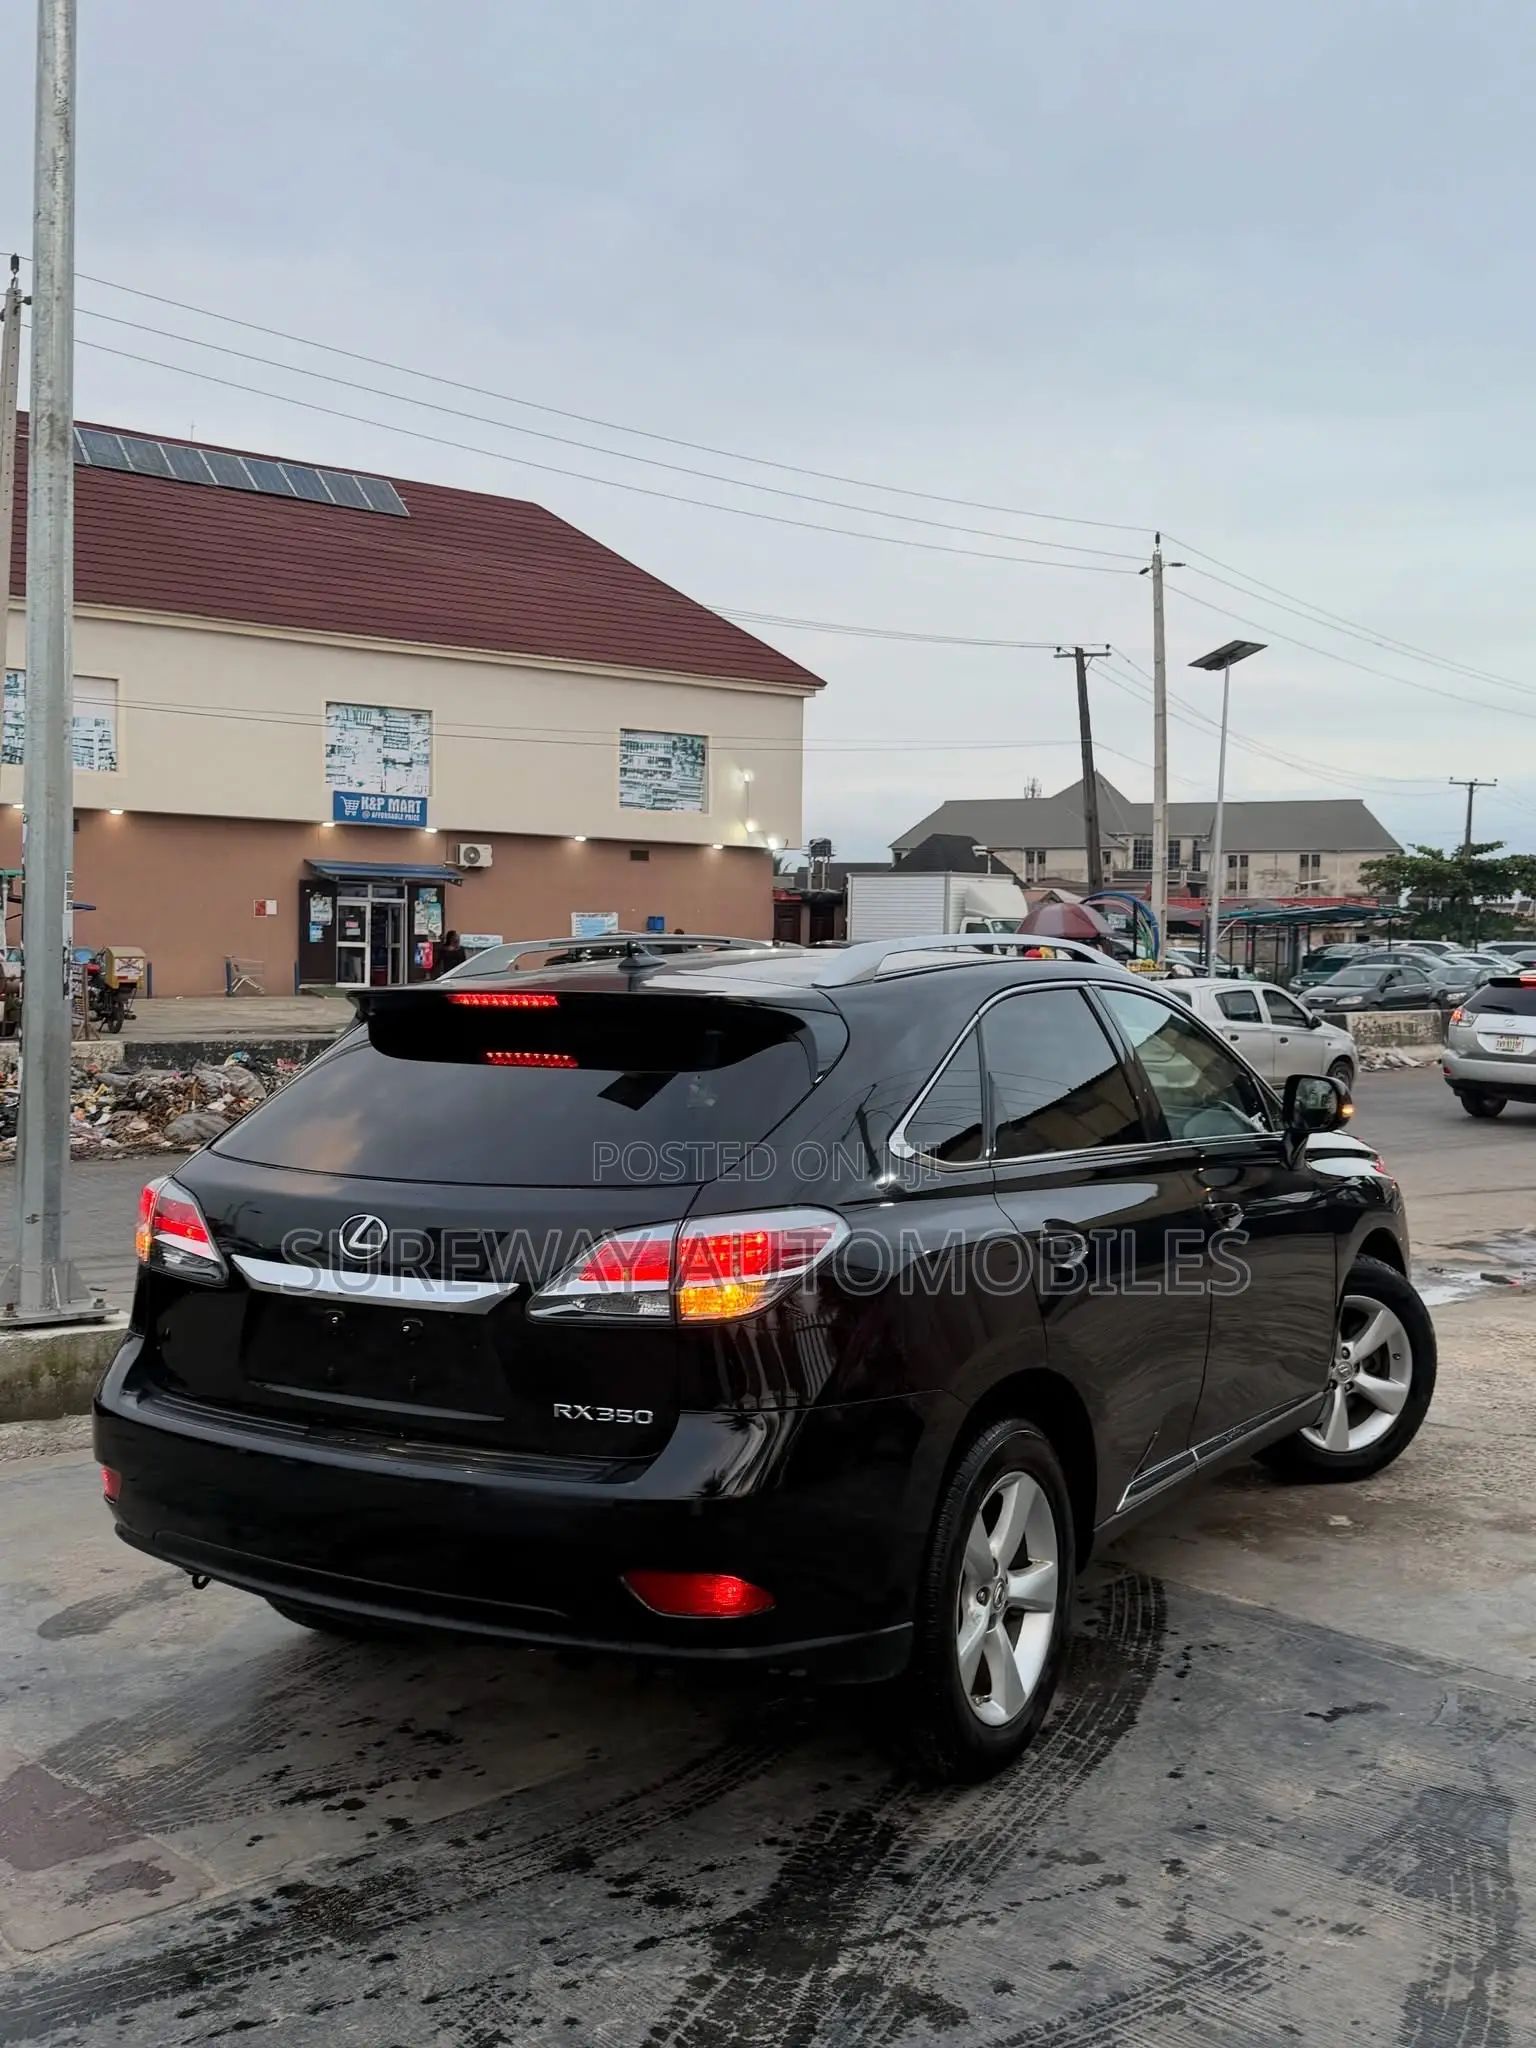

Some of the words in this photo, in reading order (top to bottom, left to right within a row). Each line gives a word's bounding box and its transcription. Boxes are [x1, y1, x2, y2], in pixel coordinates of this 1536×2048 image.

[388, 798, 422, 813] MART
[404, 813, 420, 821] PRICE
[553, 1403, 654, 1424] RX350
